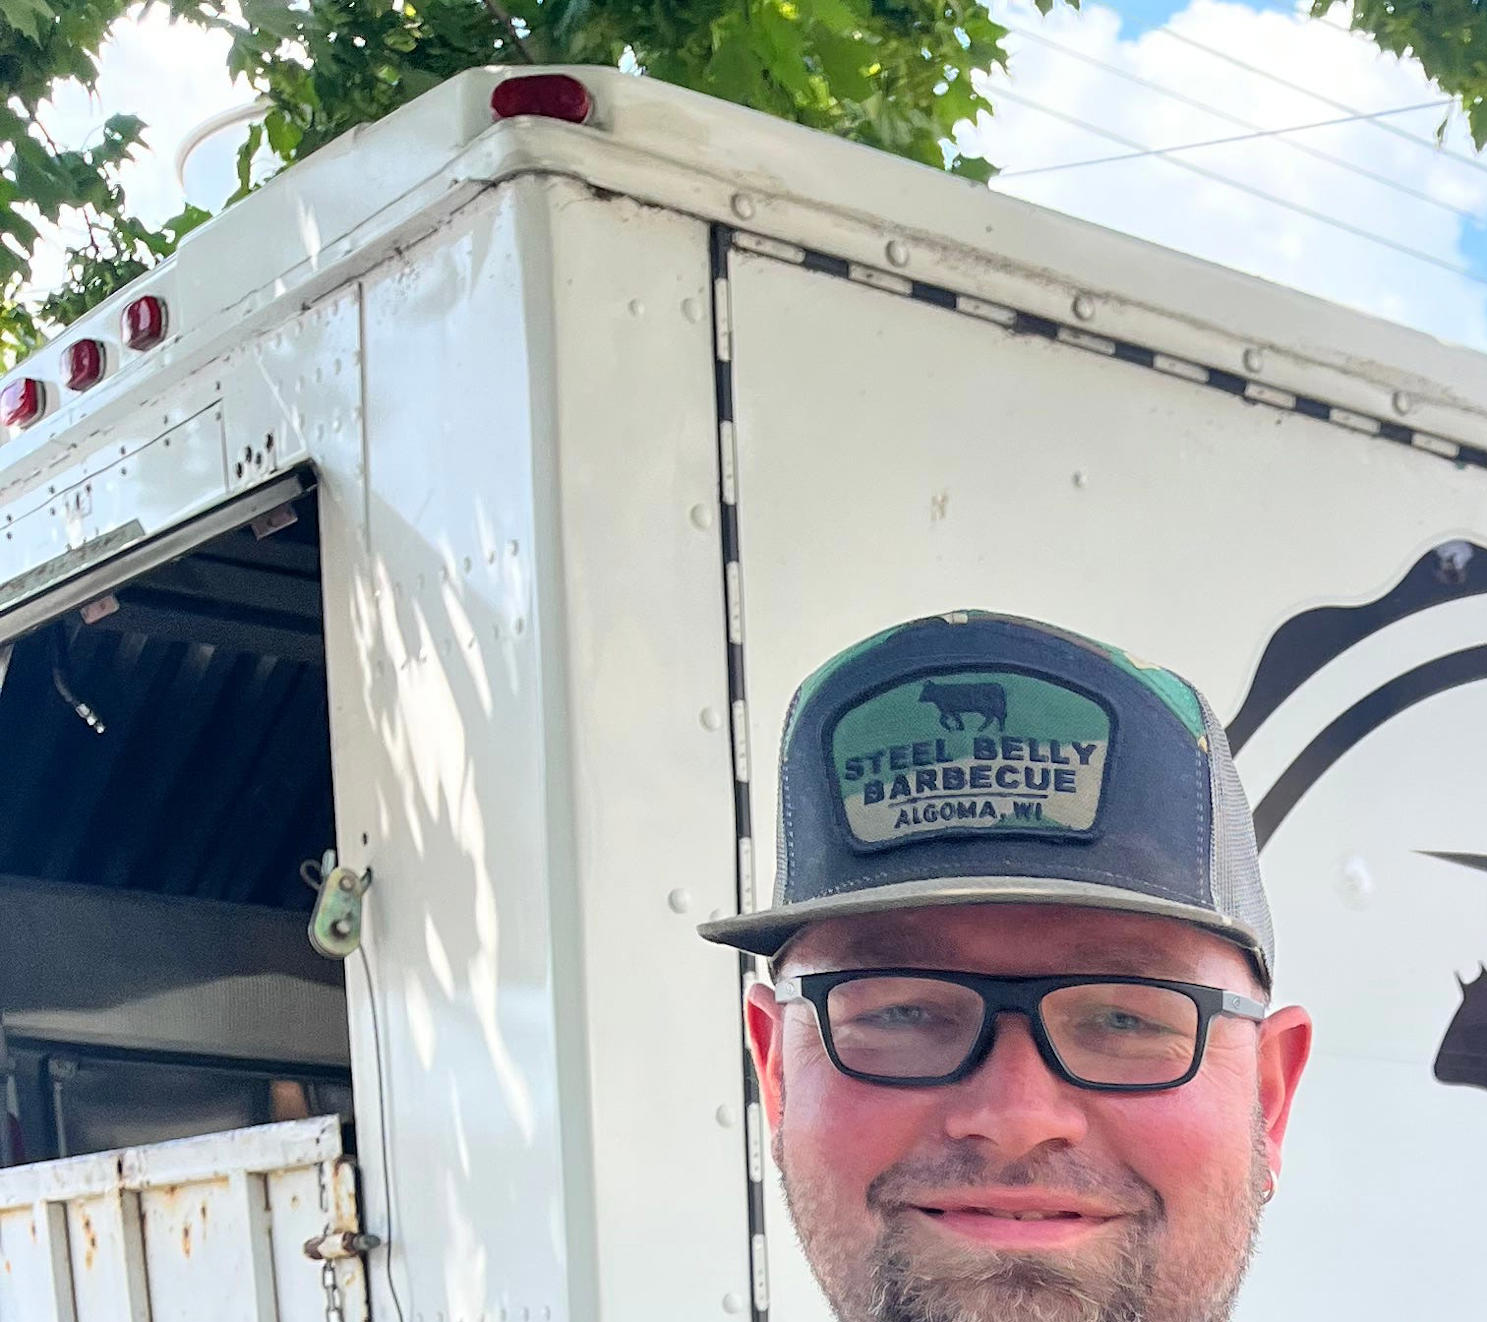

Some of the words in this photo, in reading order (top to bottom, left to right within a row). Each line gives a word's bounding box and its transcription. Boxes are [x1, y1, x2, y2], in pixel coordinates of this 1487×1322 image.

[845, 737, 955, 781] STEEL
[973, 736, 1097, 765] BELLY
[864, 765, 1076, 805] BARBECUE
[894, 801, 1004, 829] ALGOMA,
[1013, 802, 1043, 821] WI
